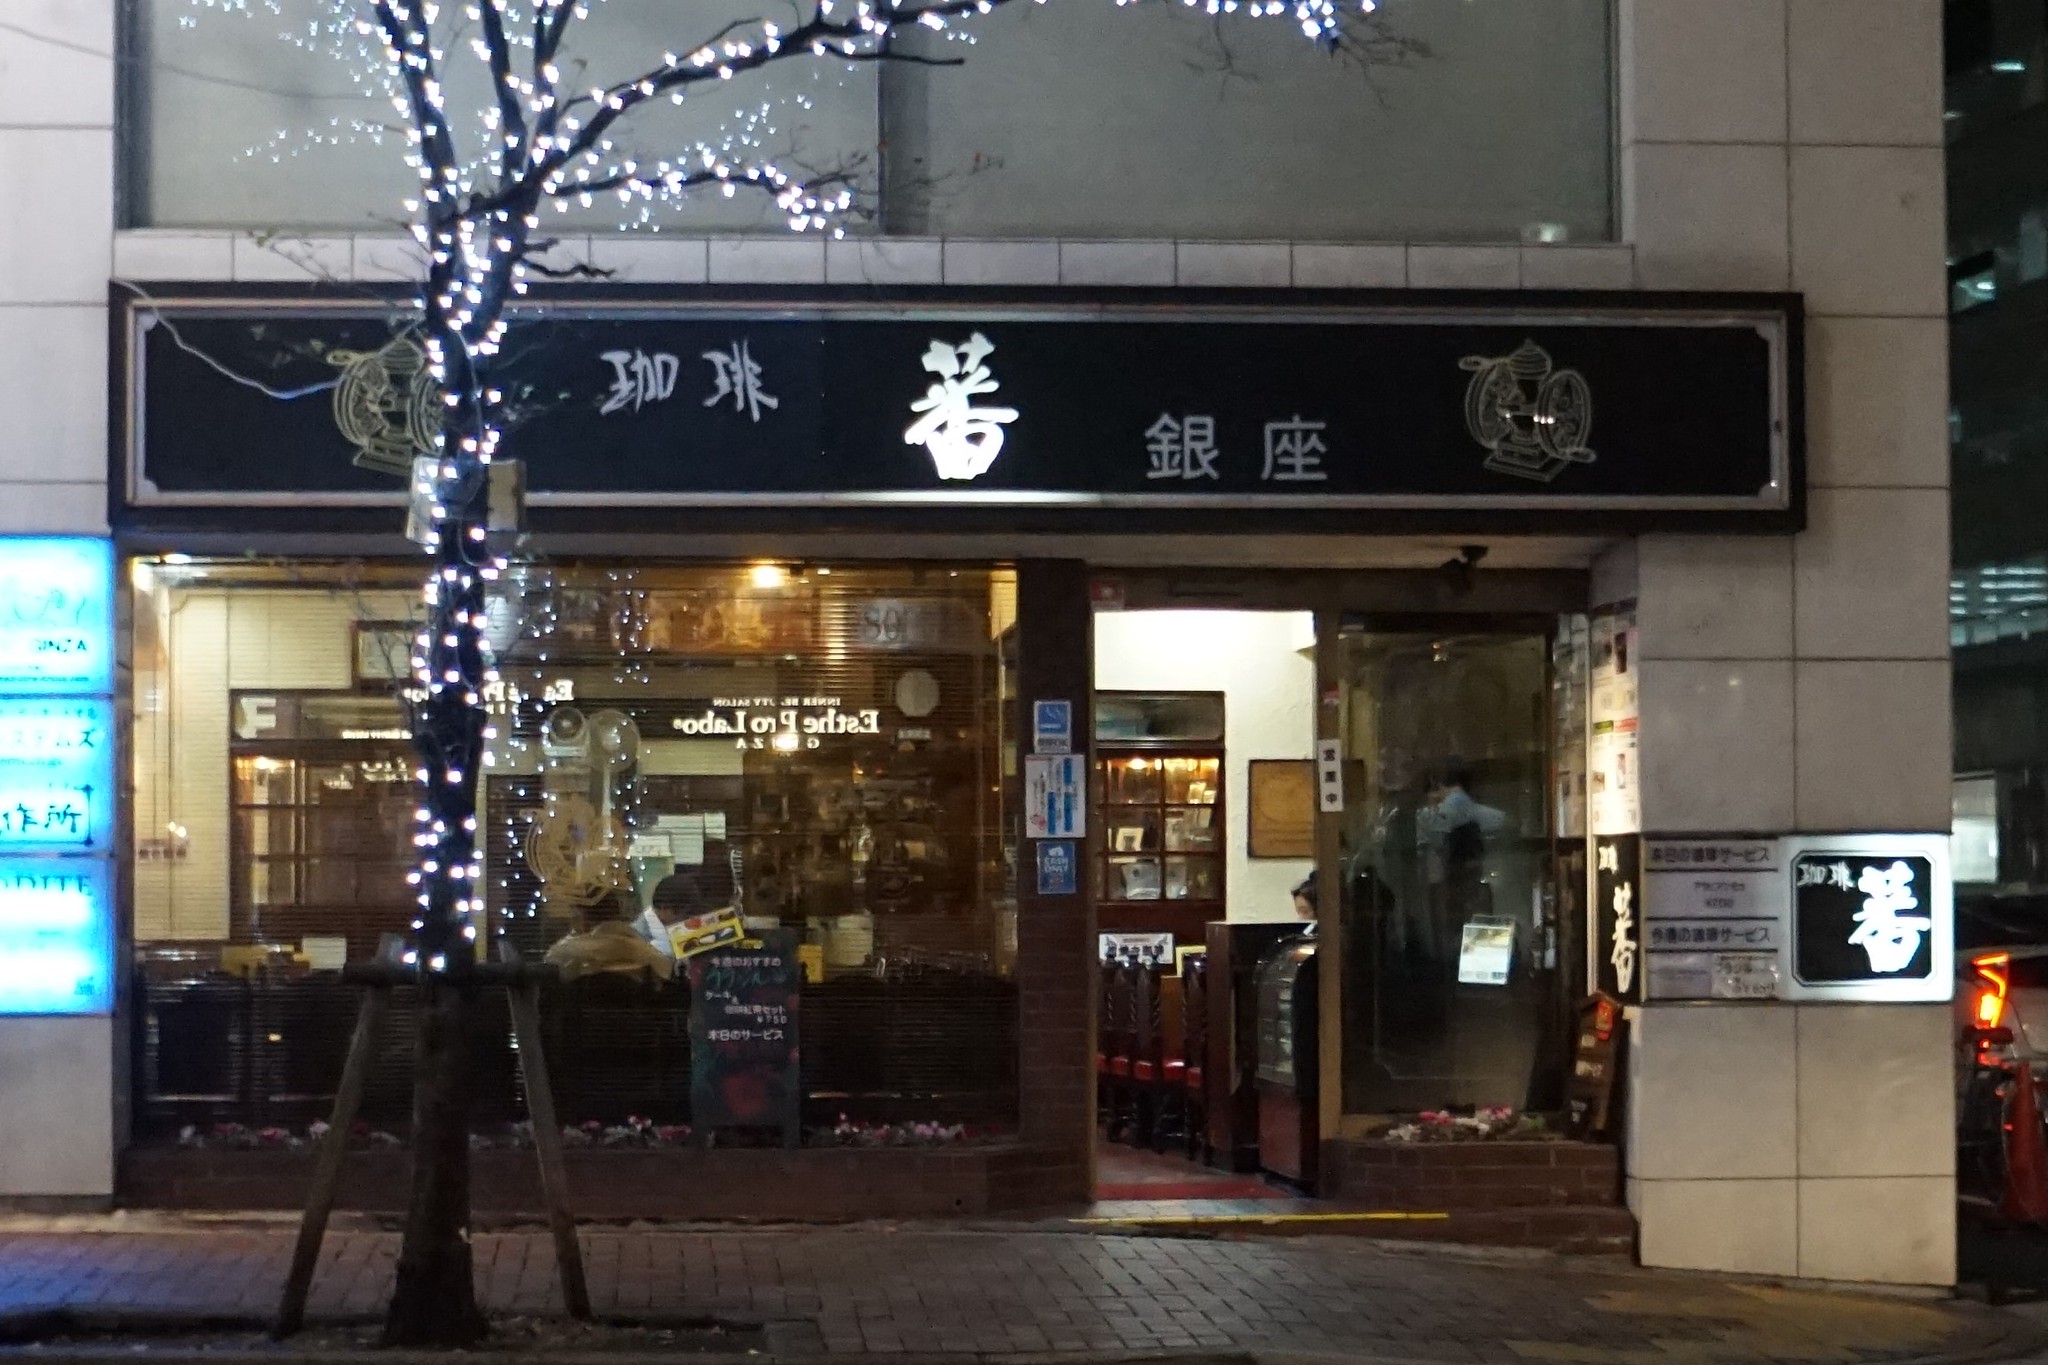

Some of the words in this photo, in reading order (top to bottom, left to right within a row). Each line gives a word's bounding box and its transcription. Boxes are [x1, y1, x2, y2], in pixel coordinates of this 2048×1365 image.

[601, 341, 779, 423] 珈琲
[1145, 413, 1328, 481] 銀座
[708, 1029, 784, 1041] 本日のサービス
